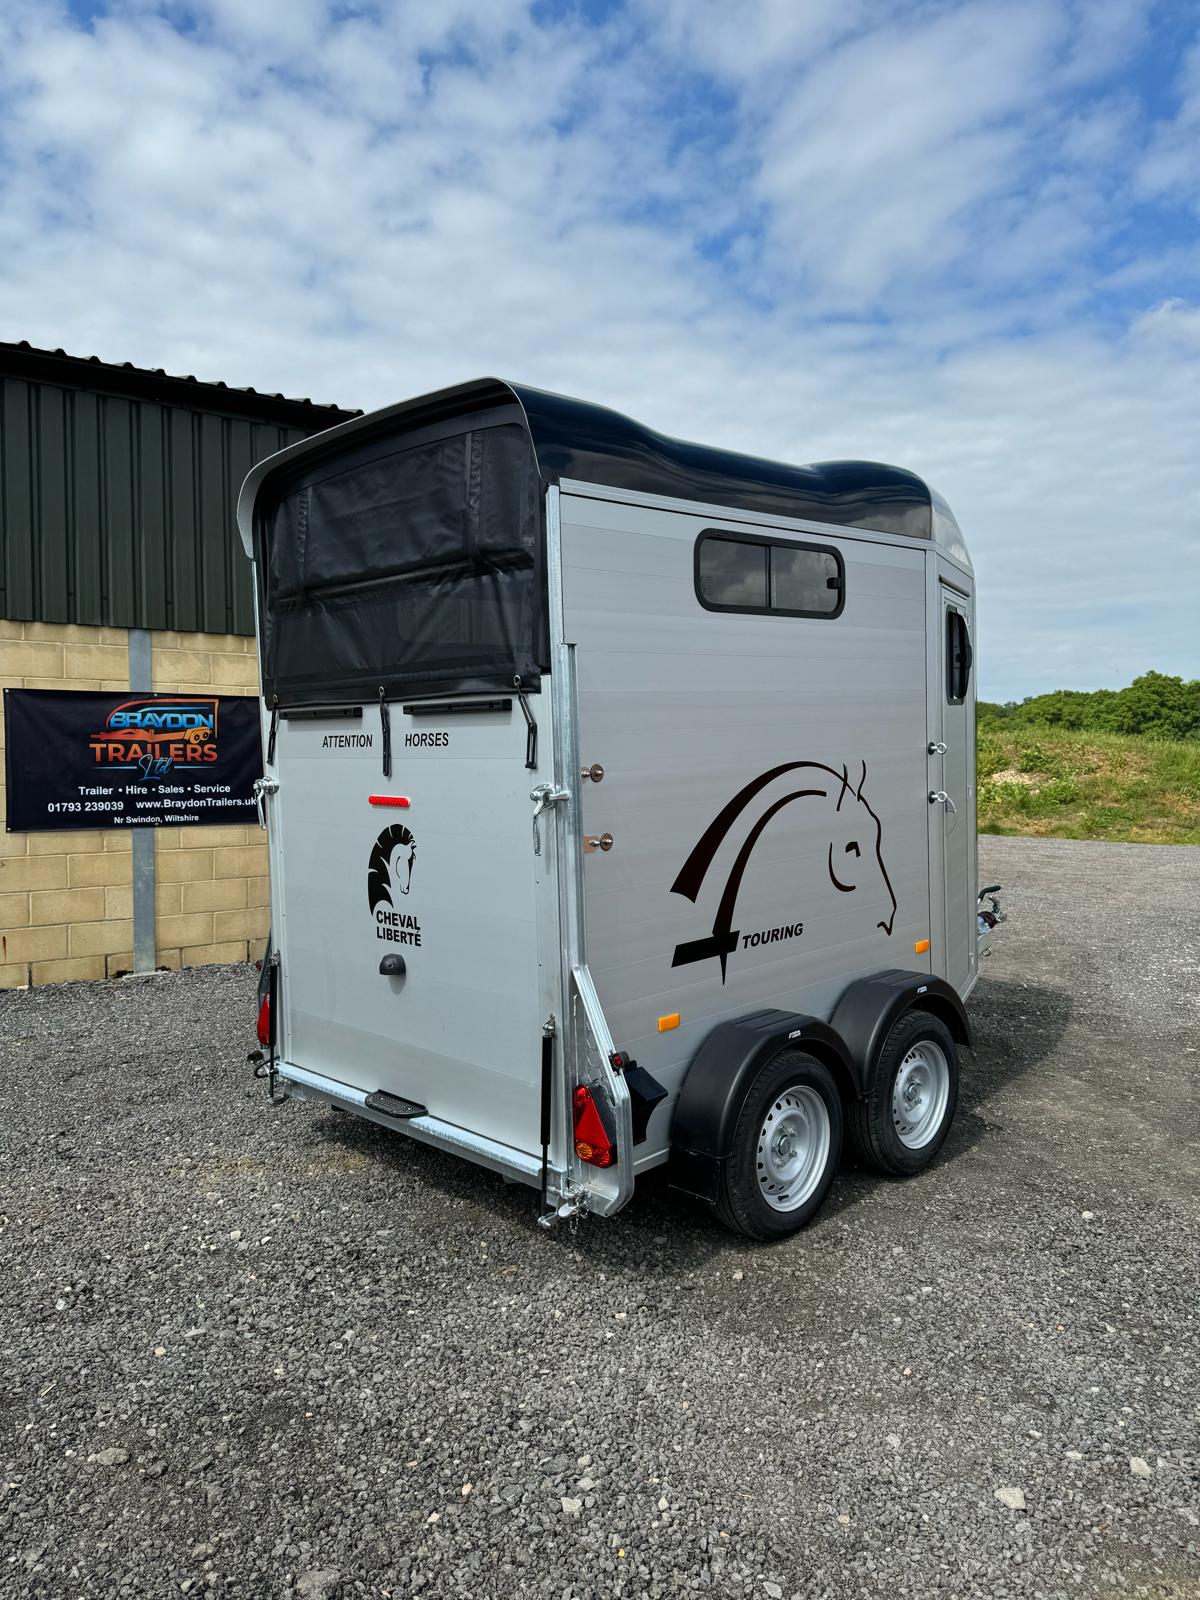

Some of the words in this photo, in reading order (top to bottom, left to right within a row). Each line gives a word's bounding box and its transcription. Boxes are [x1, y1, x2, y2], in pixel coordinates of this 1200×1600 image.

[110, 712, 213, 729] BRAYDON
[322, 734, 373, 748] ATTENTION
[405, 732, 449, 747] HORSES
[89, 743, 218, 762] TRAILERS
[137, 753, 174, 781] Ltd
[78, 786, 114, 796] Trailer
[126, 785, 148, 795] Hire
[158, 785, 185, 794] Sales
[194, 784, 231, 793] Service
[47, 803, 82, 813] 01793
[84, 802, 124, 812] 239039
[136, 798, 257, 809] www.BraydonTrailers.uk
[114, 816, 124, 824] Nr
[125, 815, 163, 824] Swindon,
[164, 814, 199, 822] Wiltshire
[376, 910, 421, 931] CHEVAL
[376, 926, 422, 947] LIBERTÉ
[742, 922, 804, 949] TOURING
